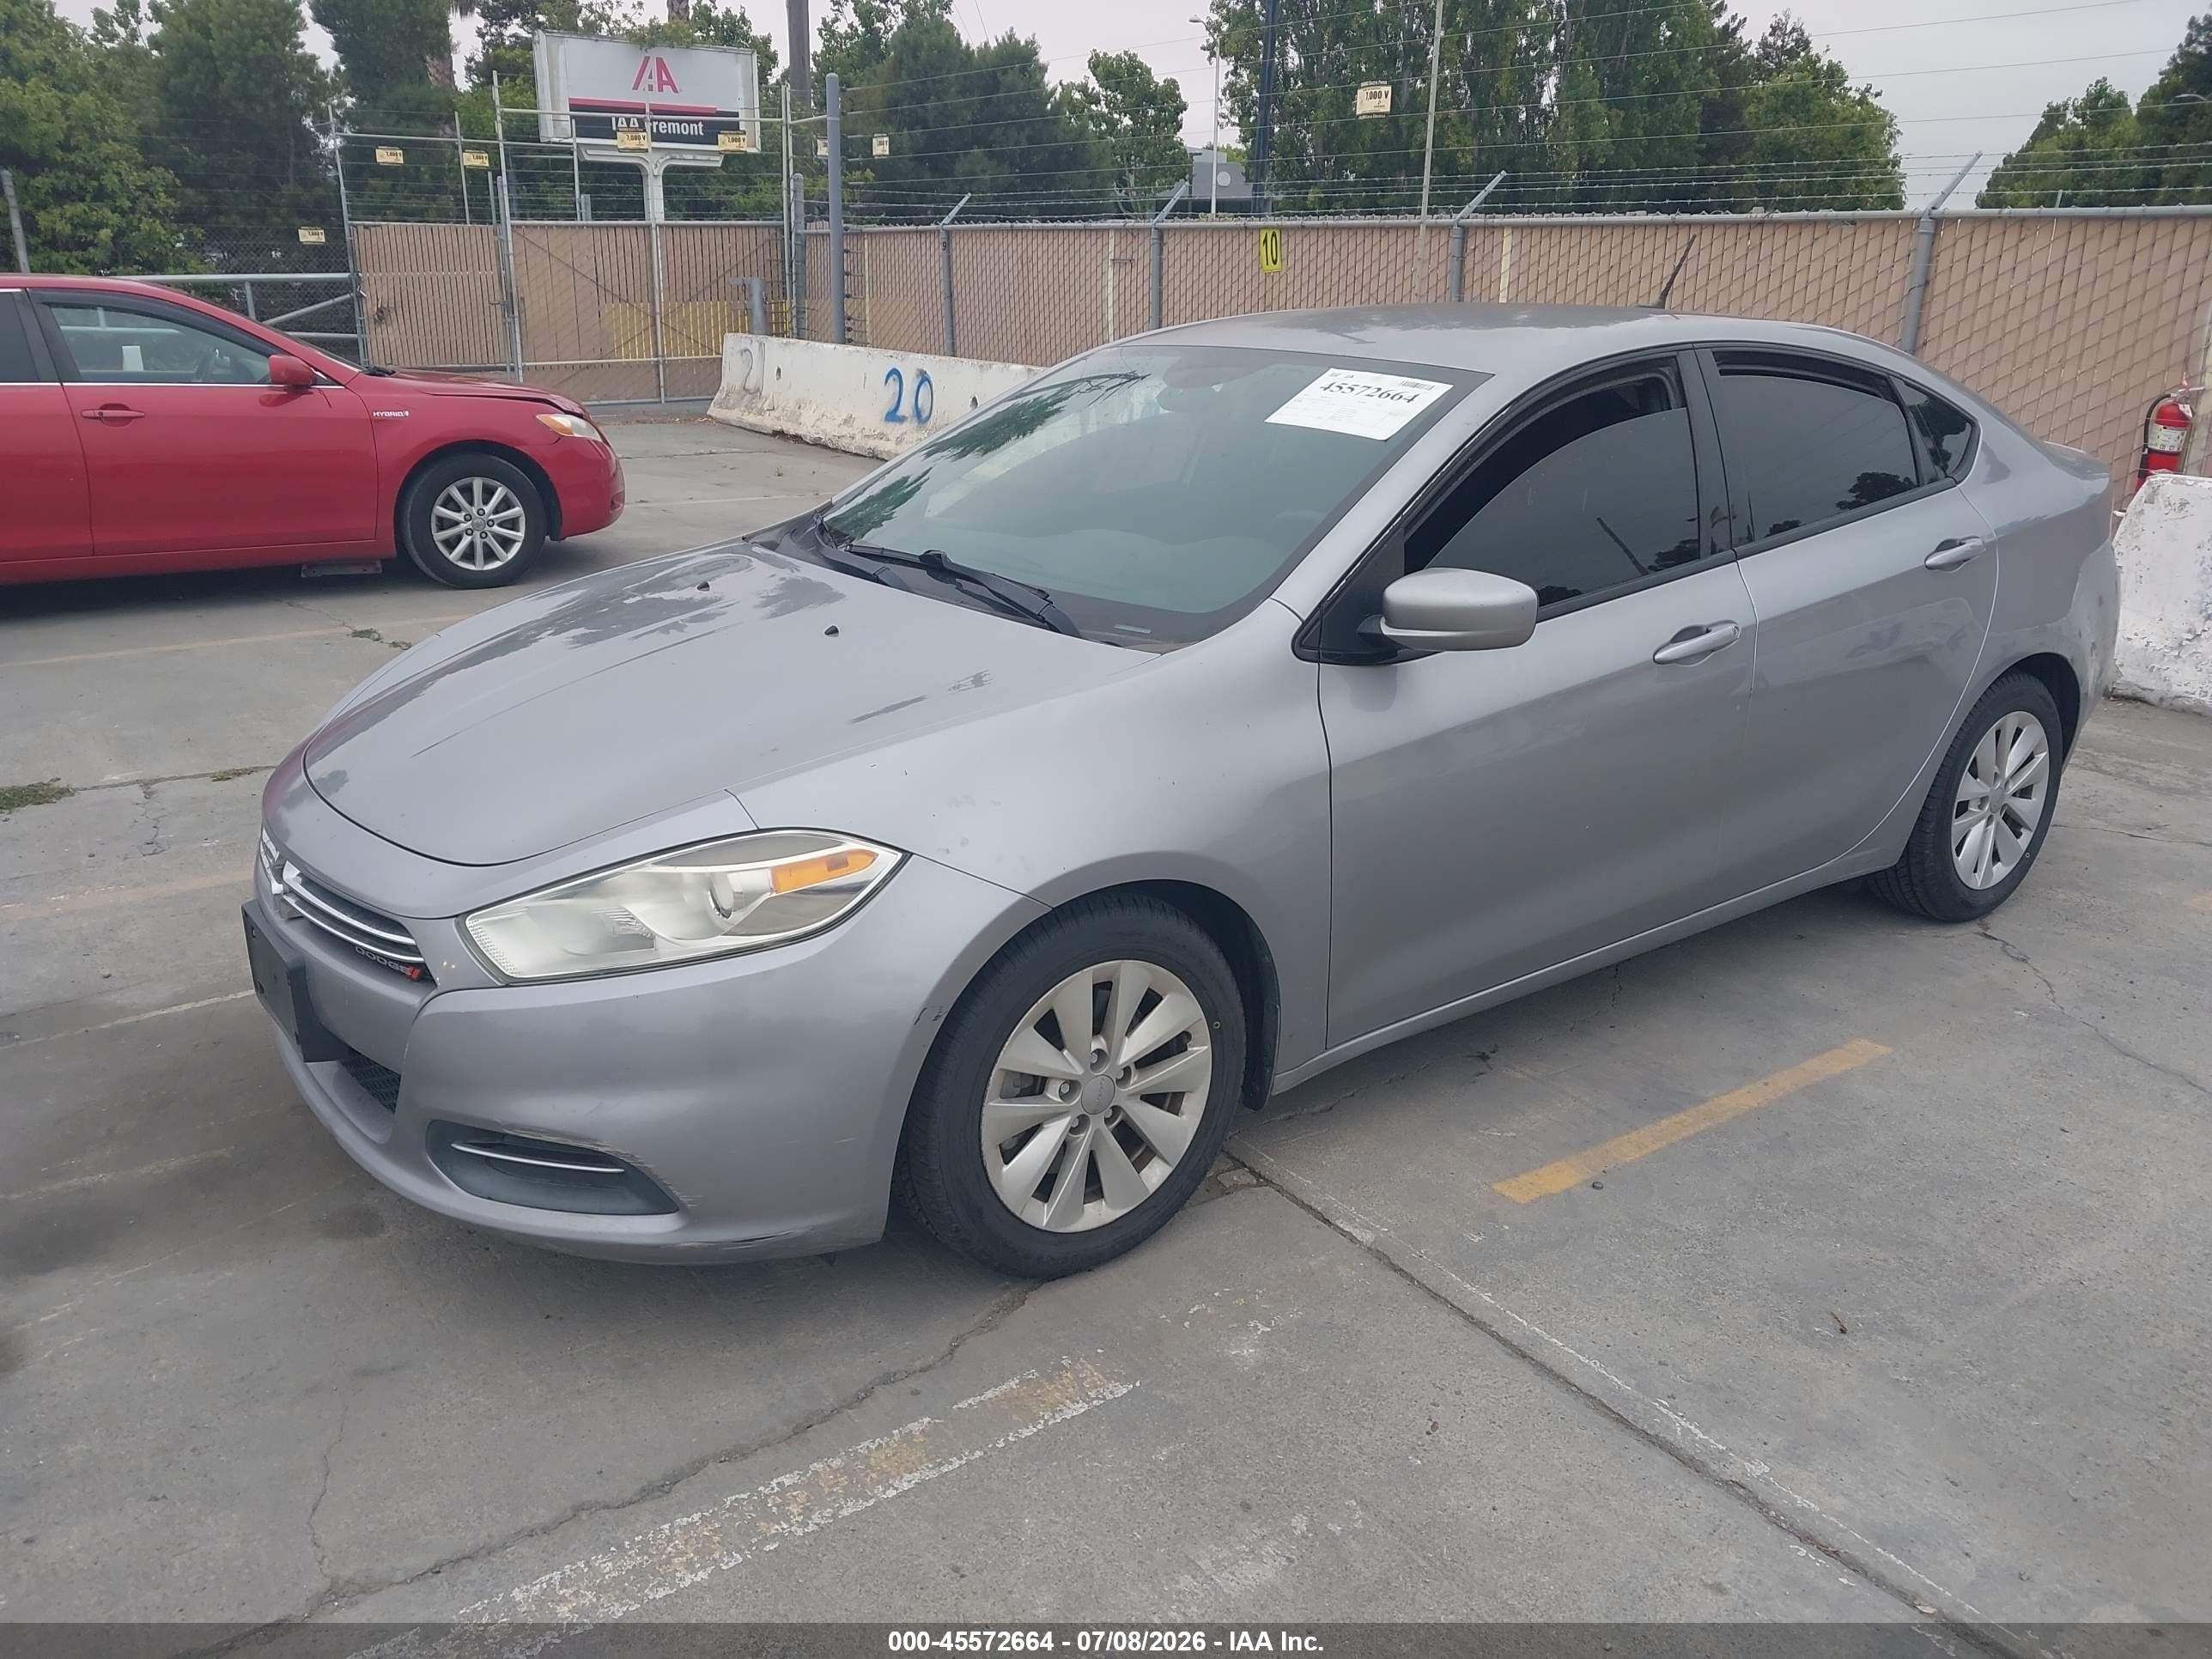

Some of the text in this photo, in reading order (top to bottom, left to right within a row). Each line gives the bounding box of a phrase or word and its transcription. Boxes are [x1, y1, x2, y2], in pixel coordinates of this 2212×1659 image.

[1365, 89, 1389, 101] 7,000 V
[1262, 231, 1278, 266] 10
[884, 367, 933, 424] 20
[1320, 381, 1420, 404] 45572664
[356, 946, 412, 975] DODGE
